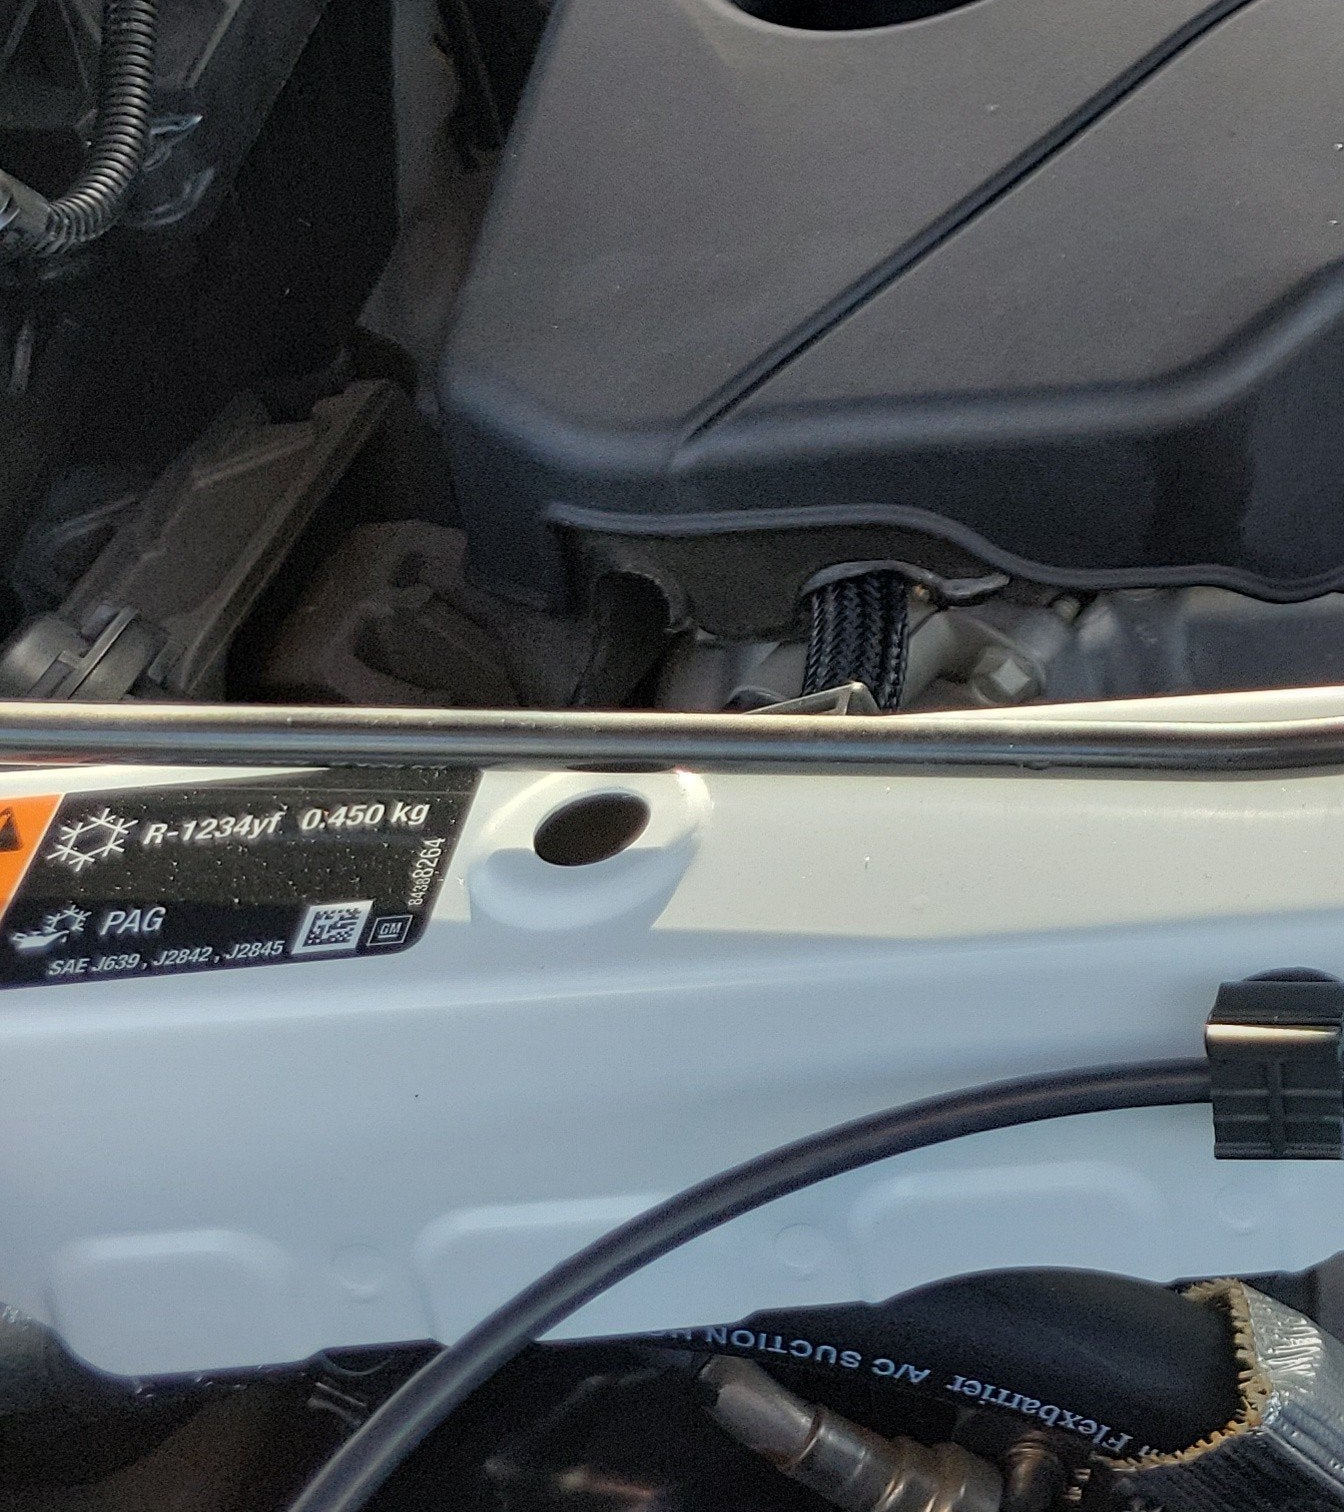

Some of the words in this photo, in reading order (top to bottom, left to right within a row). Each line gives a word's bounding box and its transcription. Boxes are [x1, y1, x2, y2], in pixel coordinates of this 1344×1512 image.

[143, 811, 286, 845] R-1234yf
[302, 803, 386, 831] 0.450
[391, 801, 430, 826] kg
[408, 837, 446, 906] 84388264
[100, 906, 167, 936] PAG
[380, 921, 403, 936] GM
[49, 957, 91, 976] SAE
[226, 939, 286, 960] J2845
[705, 1326, 863, 1369] SUCTION
[871, 1357, 931, 1384] A/C
[946, 1374, 1134, 1453] Flexbarrier
